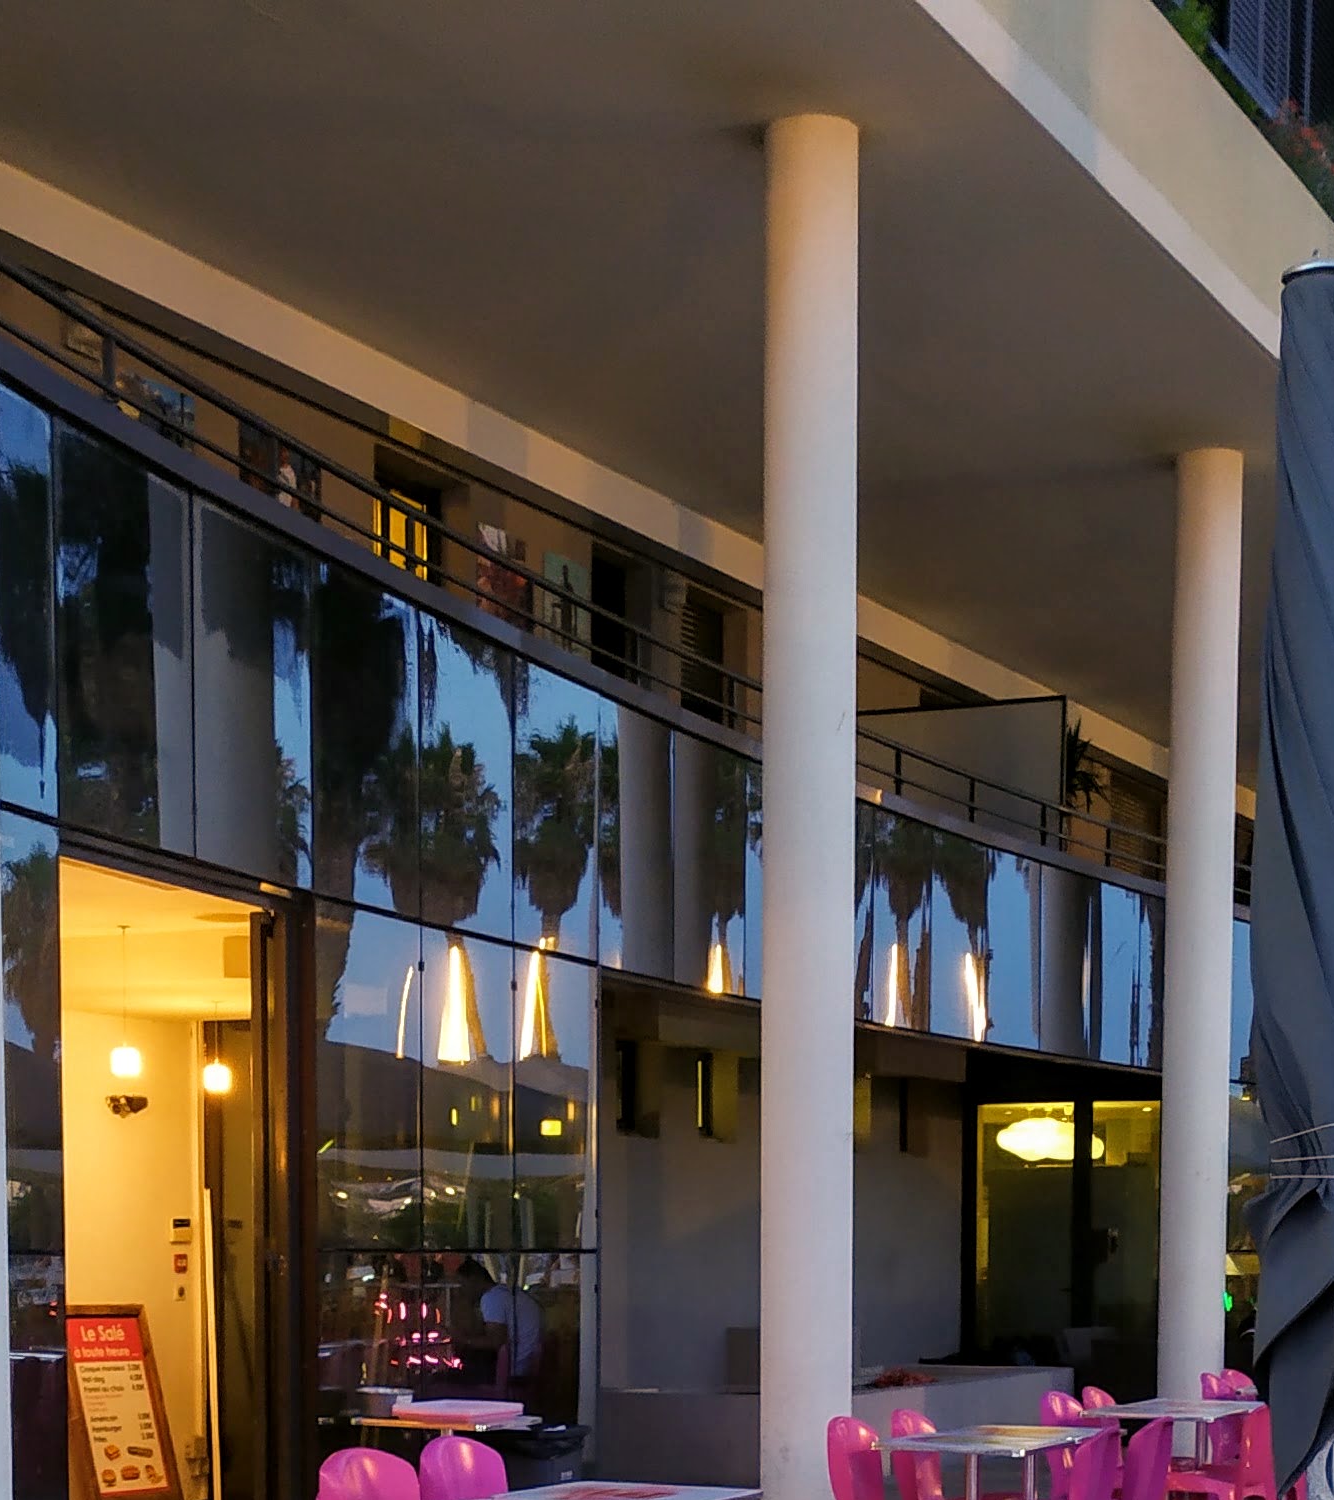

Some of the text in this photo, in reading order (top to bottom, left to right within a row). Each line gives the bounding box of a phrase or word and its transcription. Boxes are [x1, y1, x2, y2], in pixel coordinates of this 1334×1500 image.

[79, 1323, 125, 1342] Le Salé
[81, 1347, 105, 1358] toute
